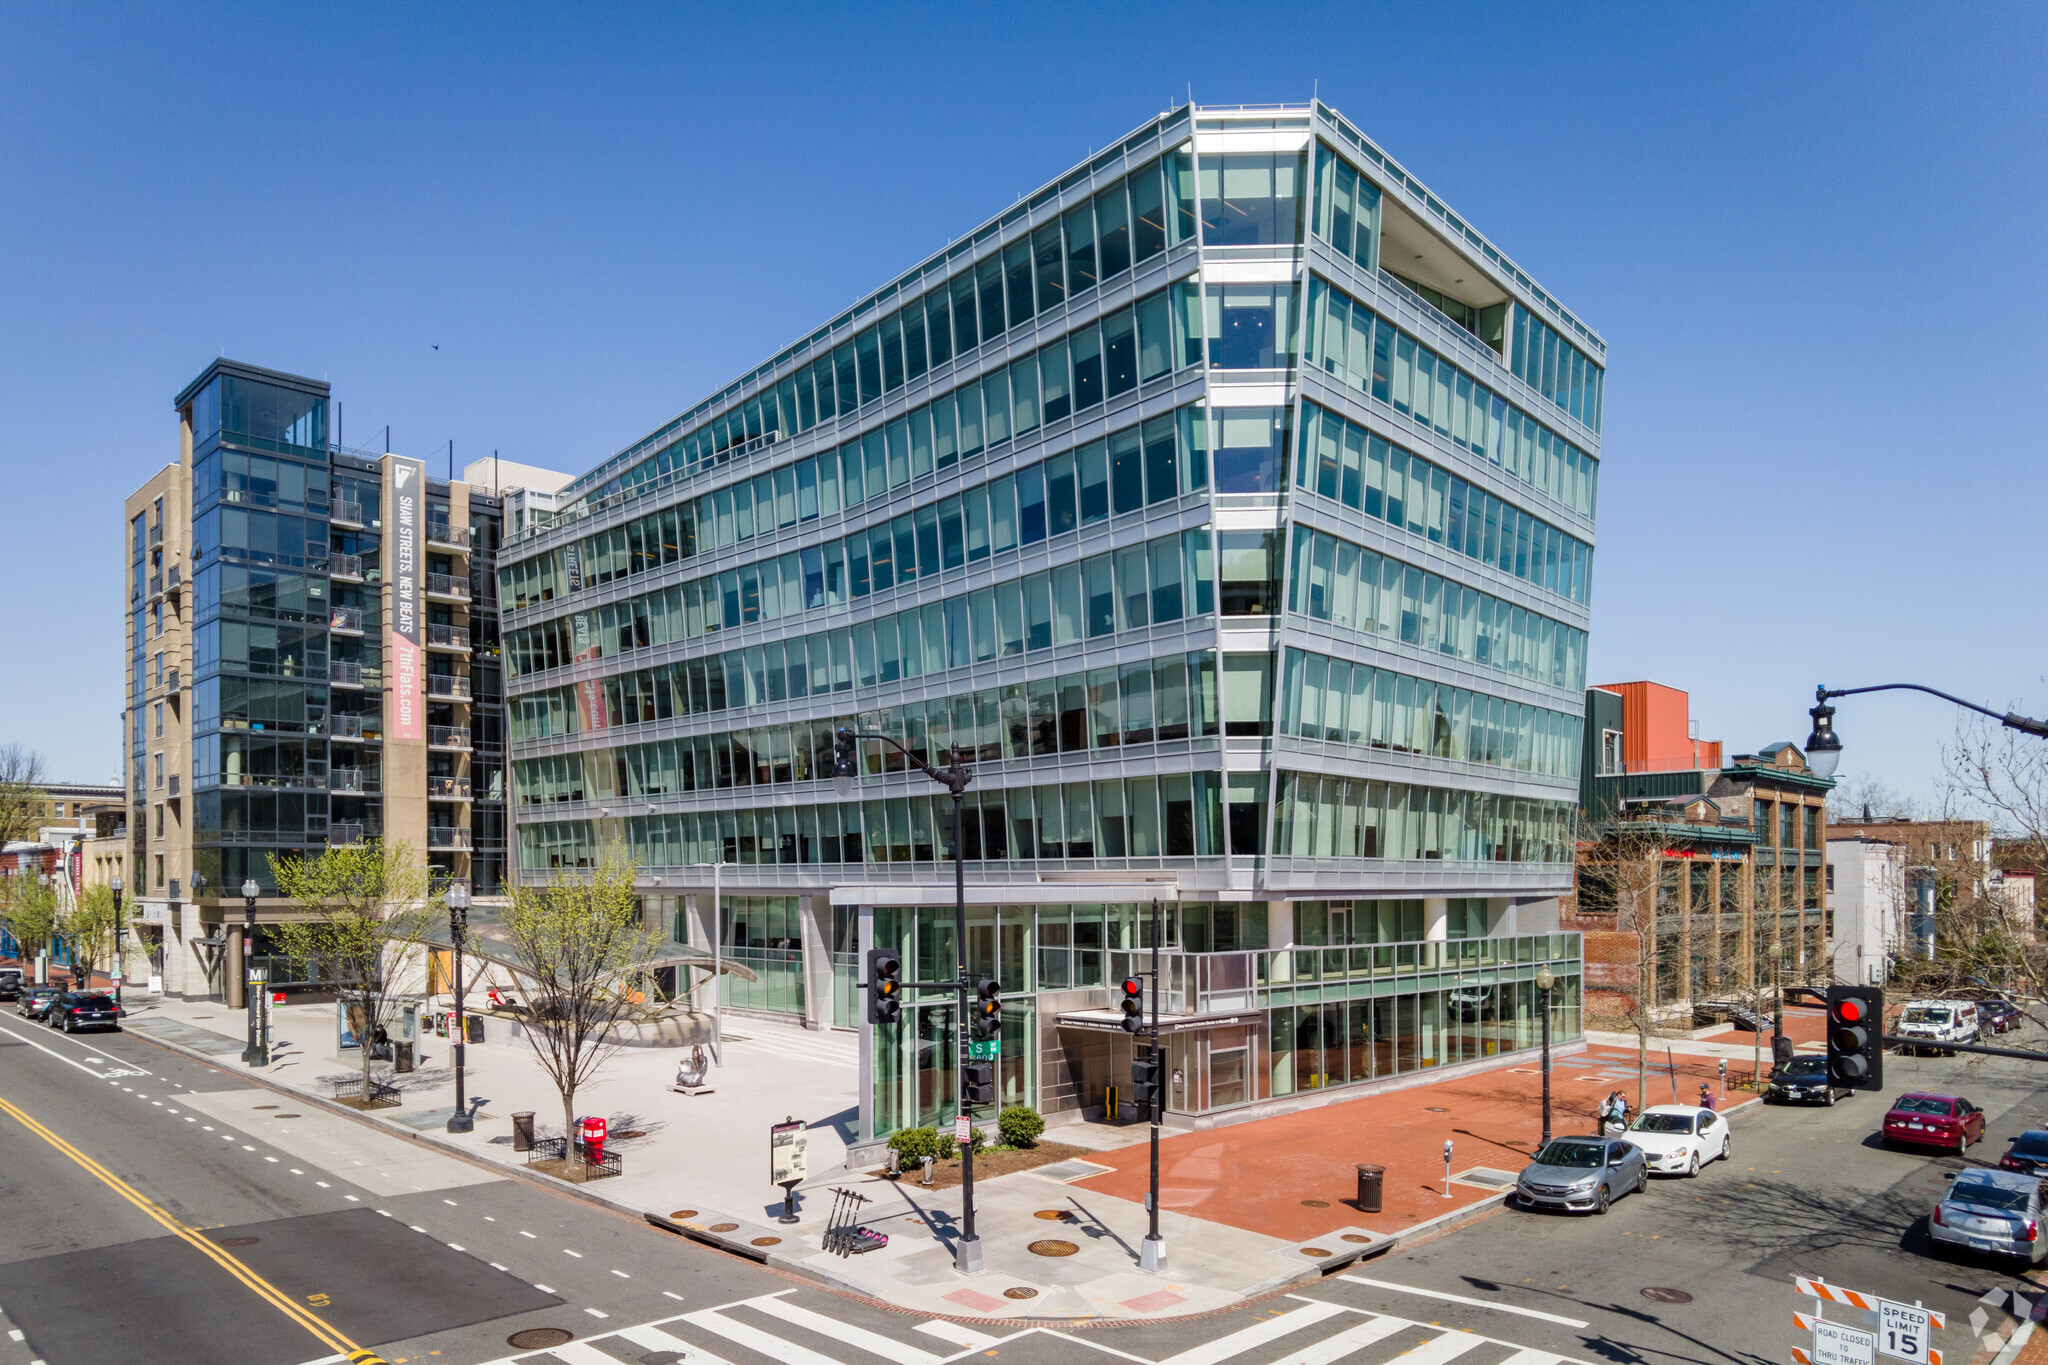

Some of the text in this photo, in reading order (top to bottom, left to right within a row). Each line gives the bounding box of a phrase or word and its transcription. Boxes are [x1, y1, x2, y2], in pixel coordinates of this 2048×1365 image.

[399, 495, 413, 633] SHAW STREETS, NEW BEATS
[399, 646, 414, 726] 7thFlats.com
[249, 969, 262, 981] M
[262, 969, 268, 980] M
[975, 1043, 983, 1054] S
[976, 1053, 994, 1061] 600
[1883, 1307, 1925, 1325] SPEED
[1887, 1319, 1920, 1334] LIMIT
[1818, 1327, 1870, 1347] ROAD CLOSED
[1888, 1330, 1919, 1355] 15
[1840, 1343, 1848, 1352] TO
[1818, 1349, 1838, 1361] THRU
